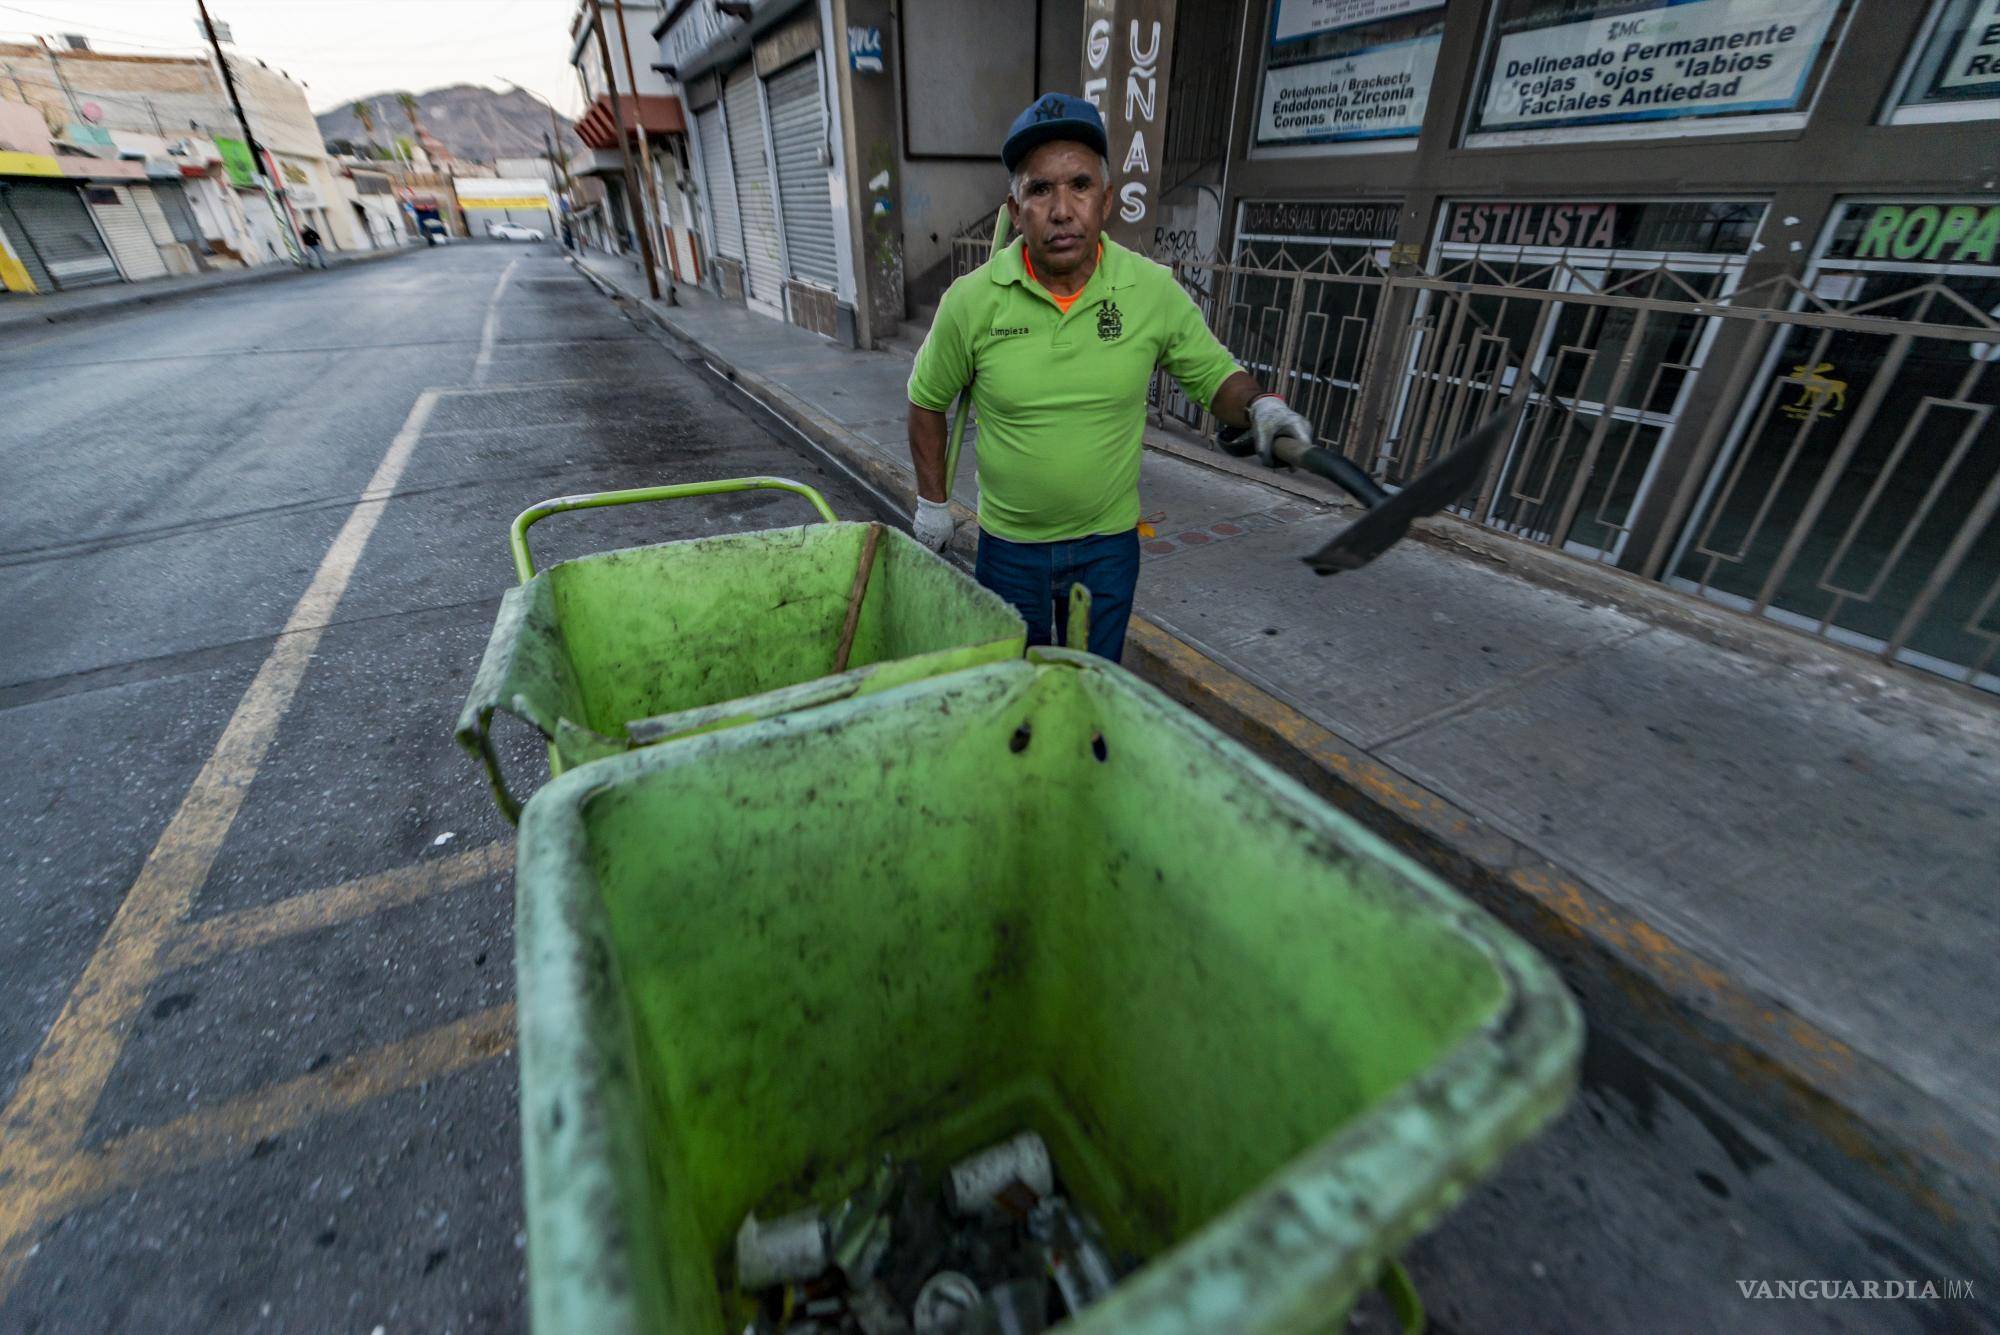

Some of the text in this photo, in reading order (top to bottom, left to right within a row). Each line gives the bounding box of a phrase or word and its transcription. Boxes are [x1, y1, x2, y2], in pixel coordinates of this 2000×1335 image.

[1505, 47, 1615, 79] Delineado
[1622, 24, 1797, 62] Permanente
[1272, 85, 1415, 115] Endodoncia Zirconia
[1279, 81, 1338, 100] Ortodoncia
[1348, 72, 1411, 91] Brackects
[1518, 77, 1741, 116] Faciales Antiedad
[1120, 19, 1161, 223] UÑAS
[1274, 112, 1325, 129] Coronas
[1333, 103, 1407, 123] Porcelana
[1273, 206, 1316, 230] CASUAL
[1319, 207, 1329, 231] Y
[1451, 203, 1617, 246] ESTILISTA
[1854, 205, 2000, 263] ROPA
[990, 325, 1030, 337] Limpieza
